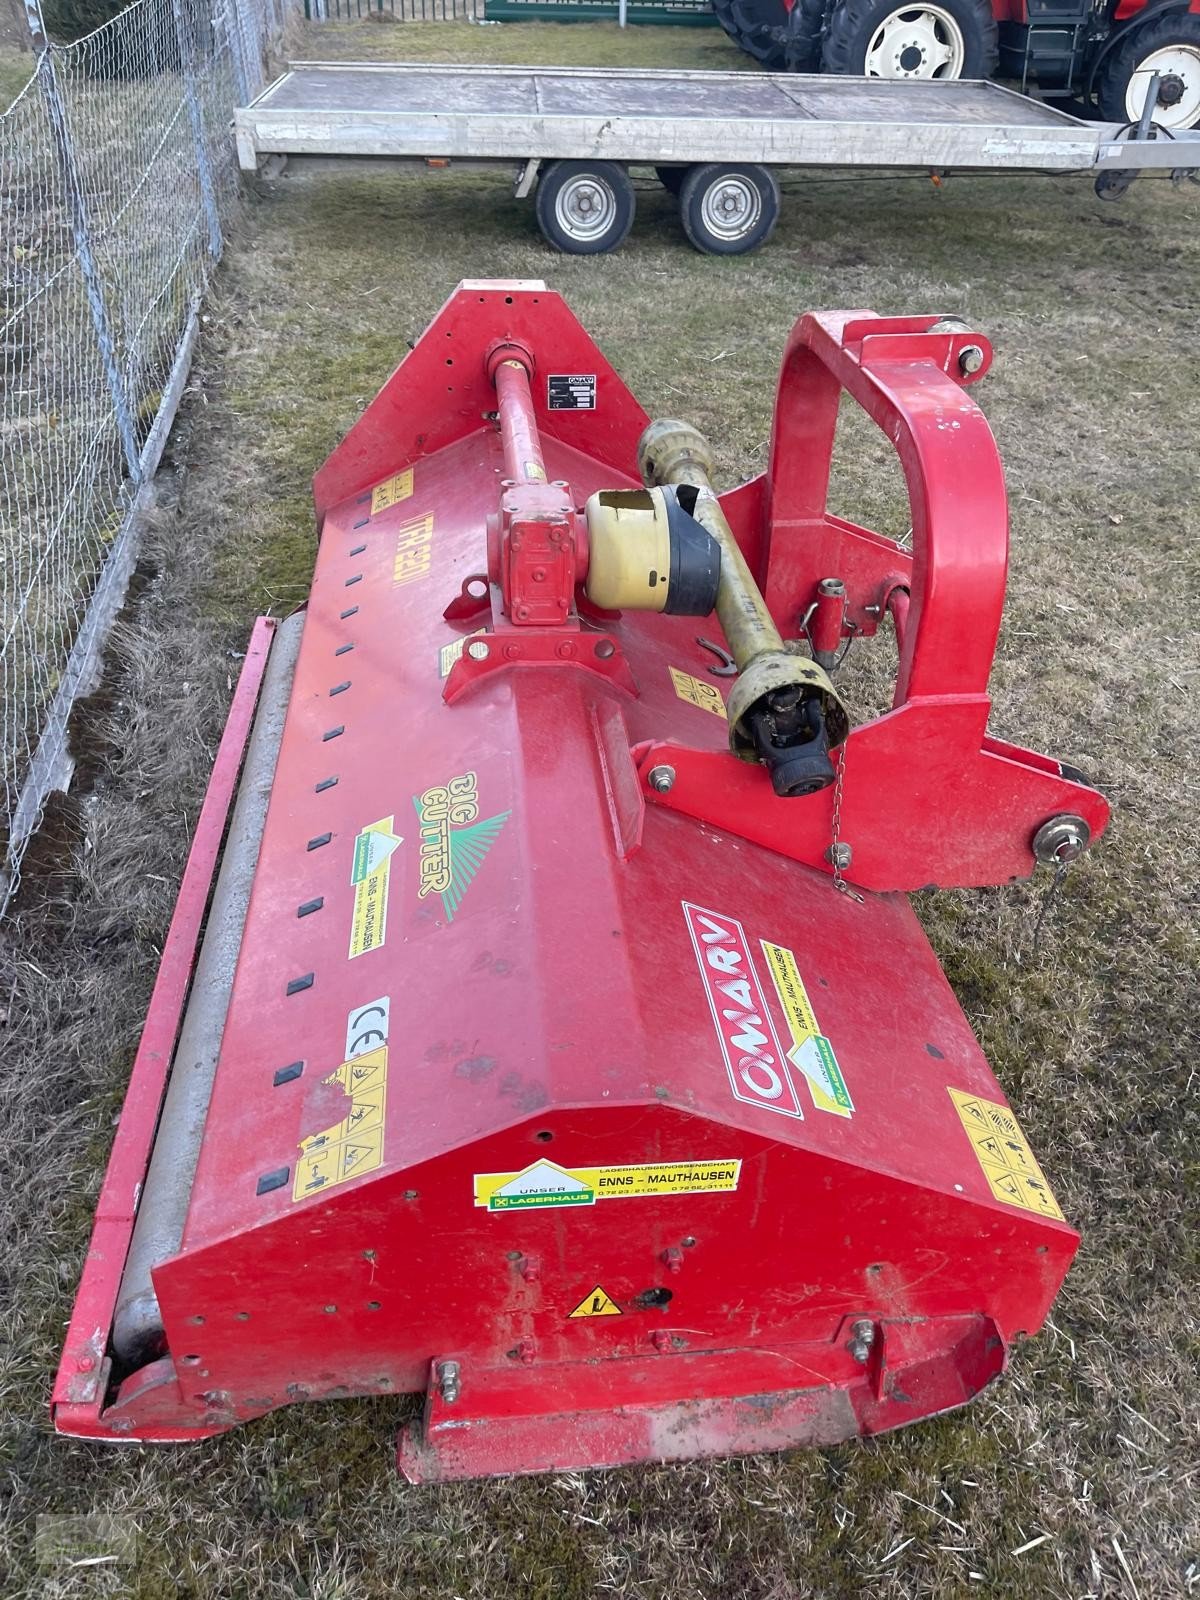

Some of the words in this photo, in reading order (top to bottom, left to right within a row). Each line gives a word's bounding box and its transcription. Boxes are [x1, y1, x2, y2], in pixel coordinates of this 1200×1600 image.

[448, 771, 478, 825] BIG
[418, 787, 452, 899] CUTTER
[368, 876, 378, 897] ENNS
[362, 900, 376, 951] MAUTHAUSEN
[773, 946, 797, 1000] MAUTHAUSEN
[695, 913, 783, 1100] OMARV
[793, 1006, 808, 1030] ENNS
[814, 1051, 829, 1083] UNSER
[819, 1039, 844, 1095] LAGERHAUS
[599, 1161, 737, 1174] LAGERHAUSGENOSSENSCHAFT
[599, 1176, 634, 1187] ENNS
[647, 1171, 735, 1184] MAUTHAUSEN
[509, 1194, 590, 1205] LAGERHAUS
